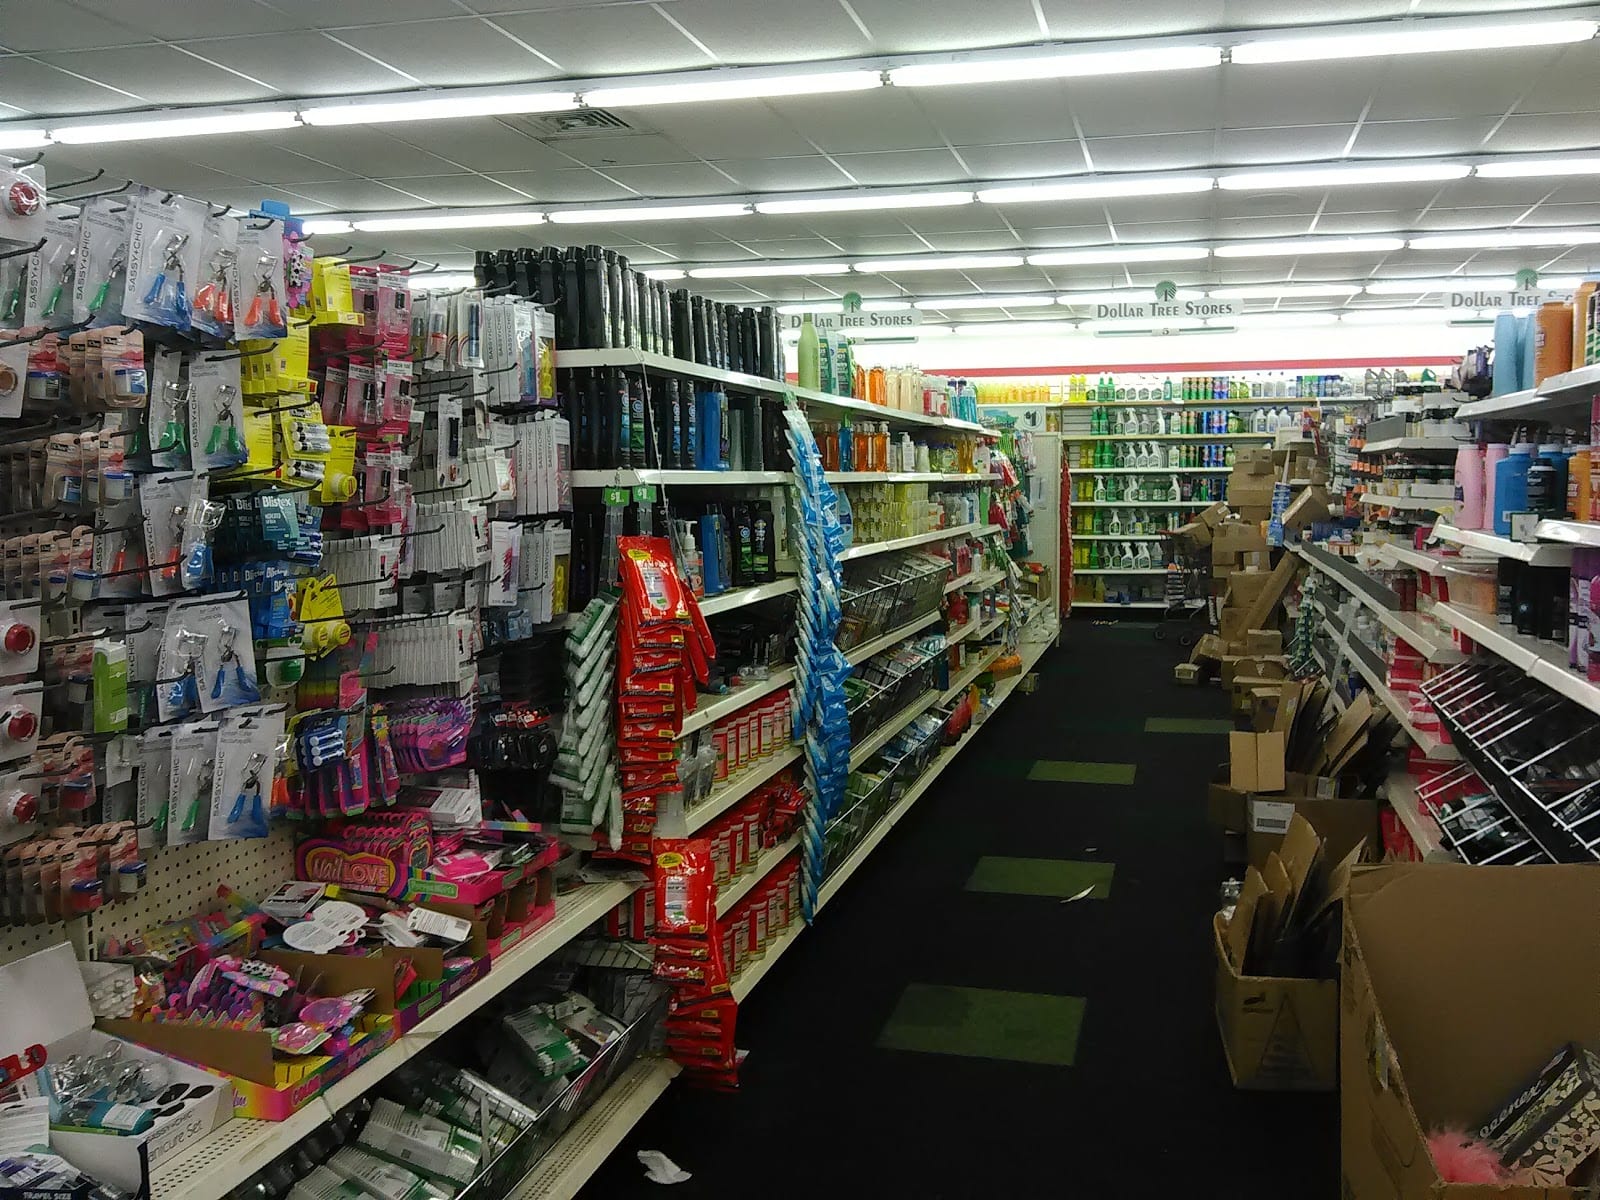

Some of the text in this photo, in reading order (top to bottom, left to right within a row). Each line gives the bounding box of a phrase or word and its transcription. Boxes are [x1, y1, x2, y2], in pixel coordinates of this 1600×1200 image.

[129, 221, 143, 292] SASSY+CHIC
[791, 313, 833, 329] Dlar
[262, 496, 291, 508] Blistex
